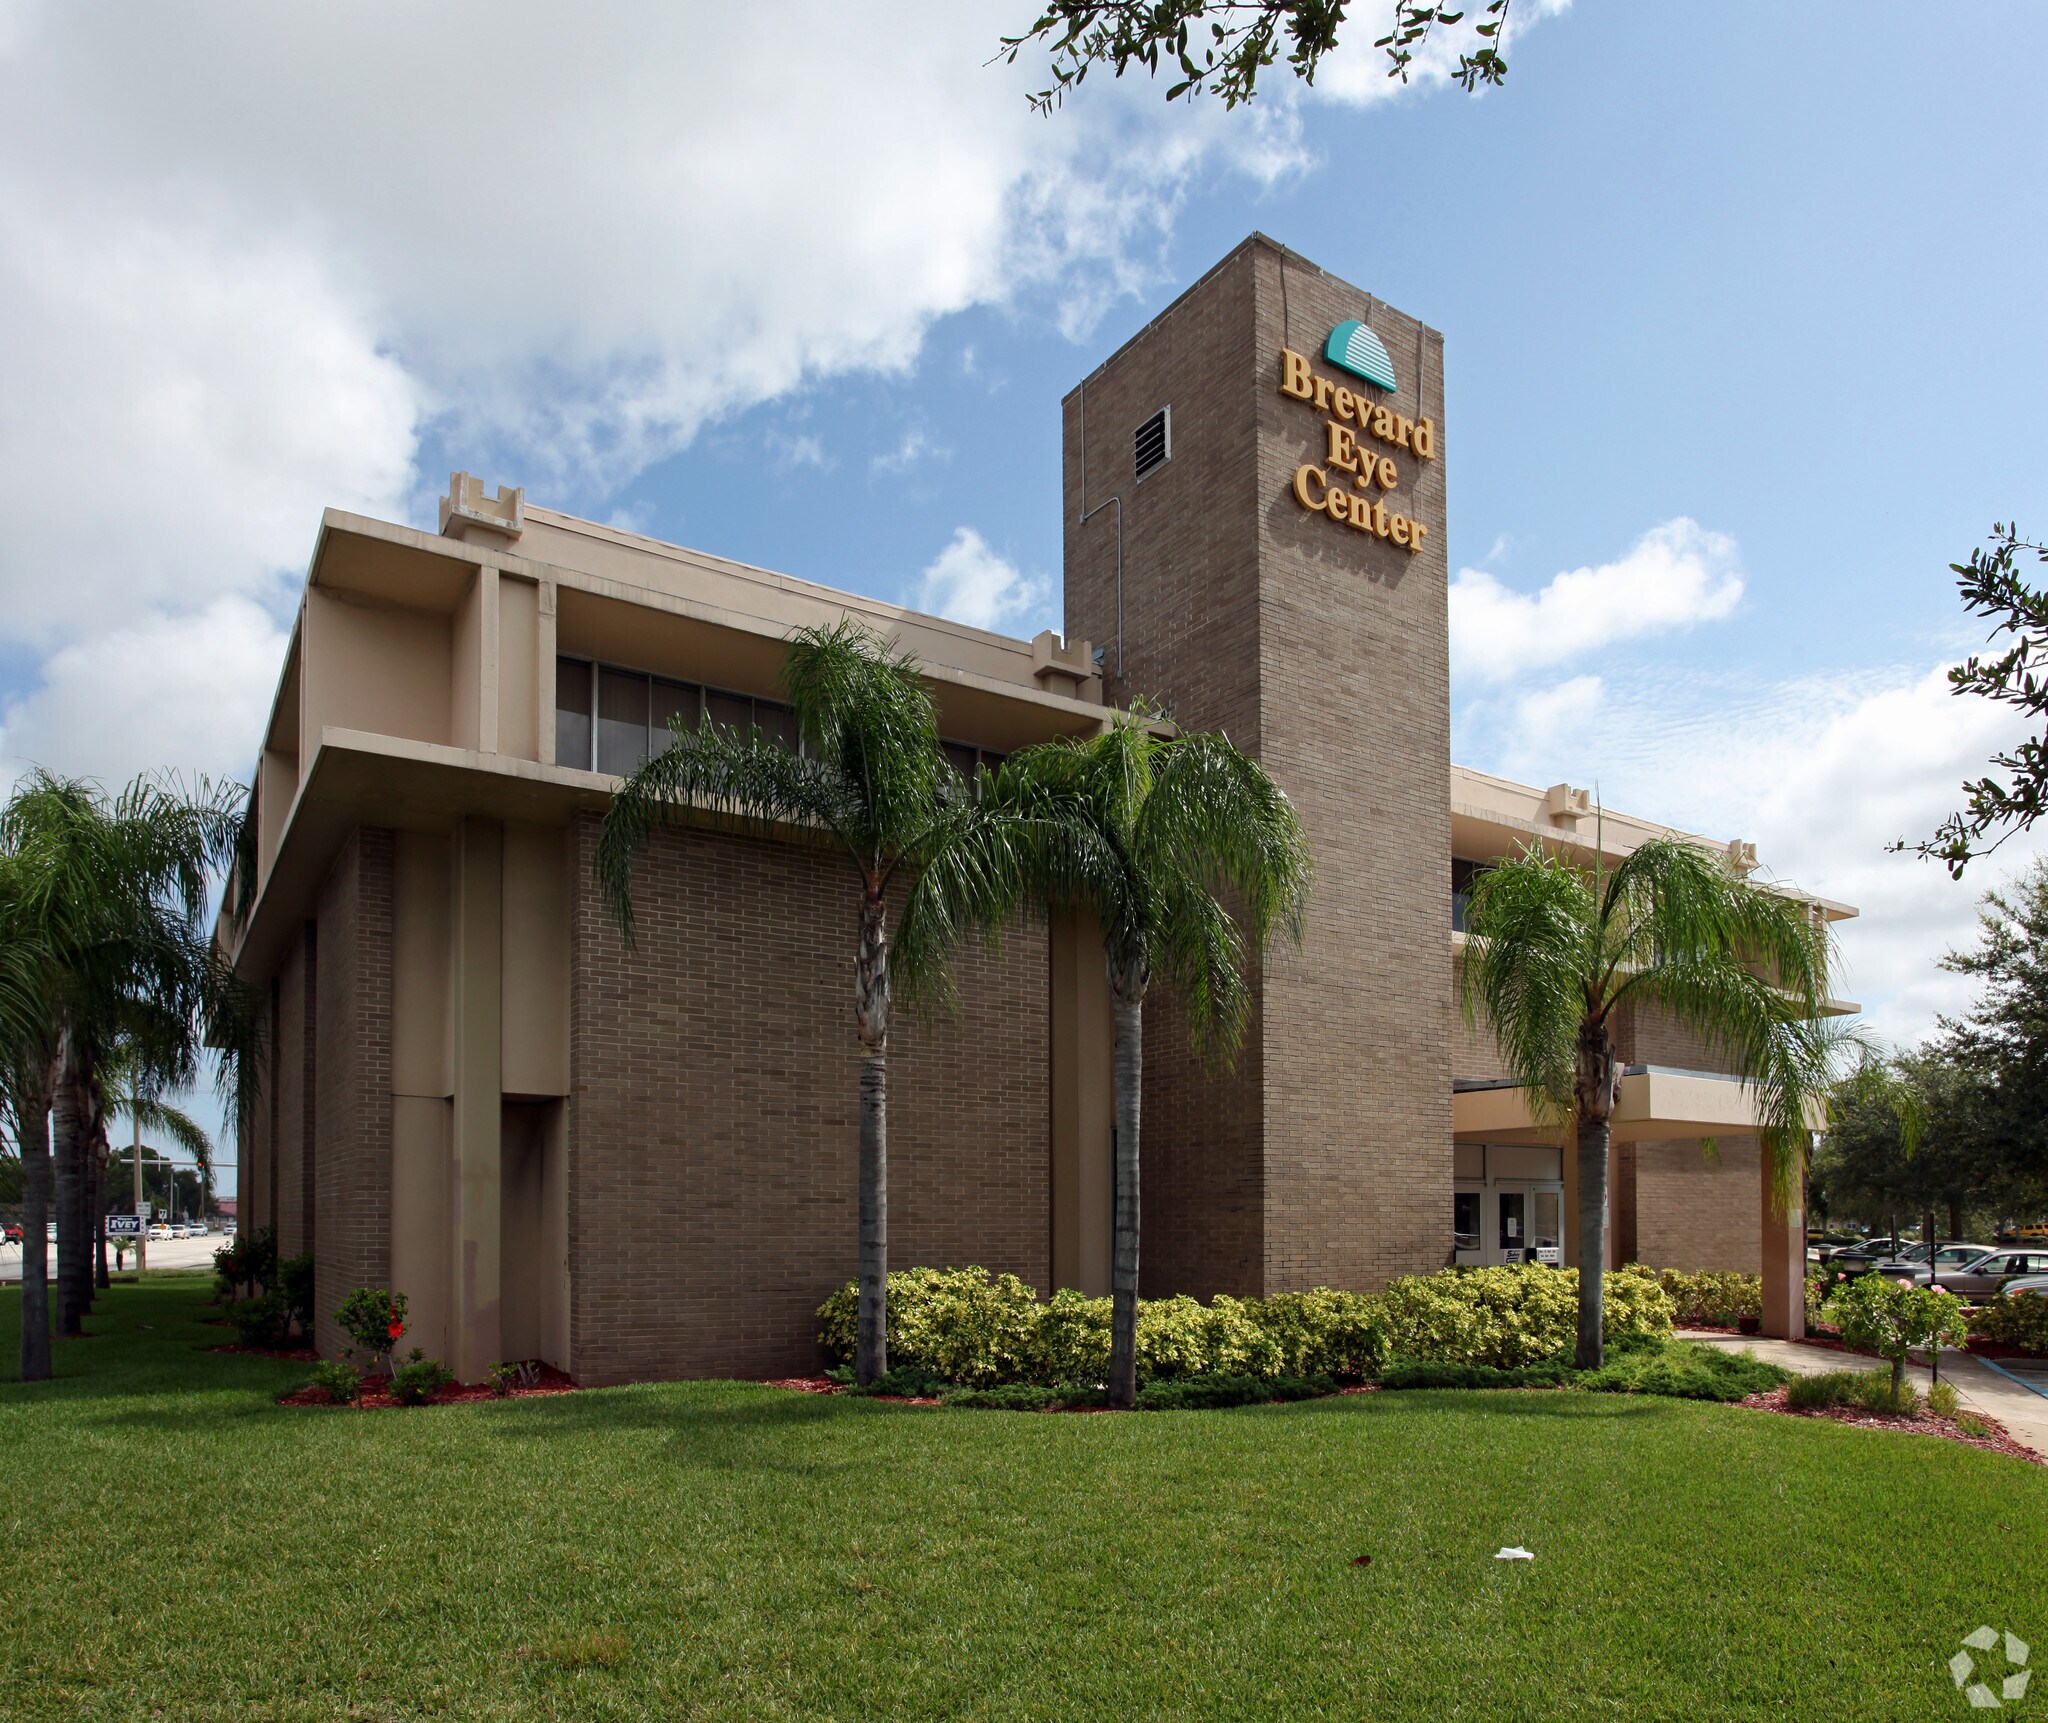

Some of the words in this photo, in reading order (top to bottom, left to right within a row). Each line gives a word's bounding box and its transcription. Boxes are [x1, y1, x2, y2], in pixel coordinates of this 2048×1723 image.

[1280, 347, 1435, 461] Brevard
[1326, 420, 1398, 490] Eye
[1293, 464, 1428, 553] Center
[110, 1220, 139, 1228] IVEY
